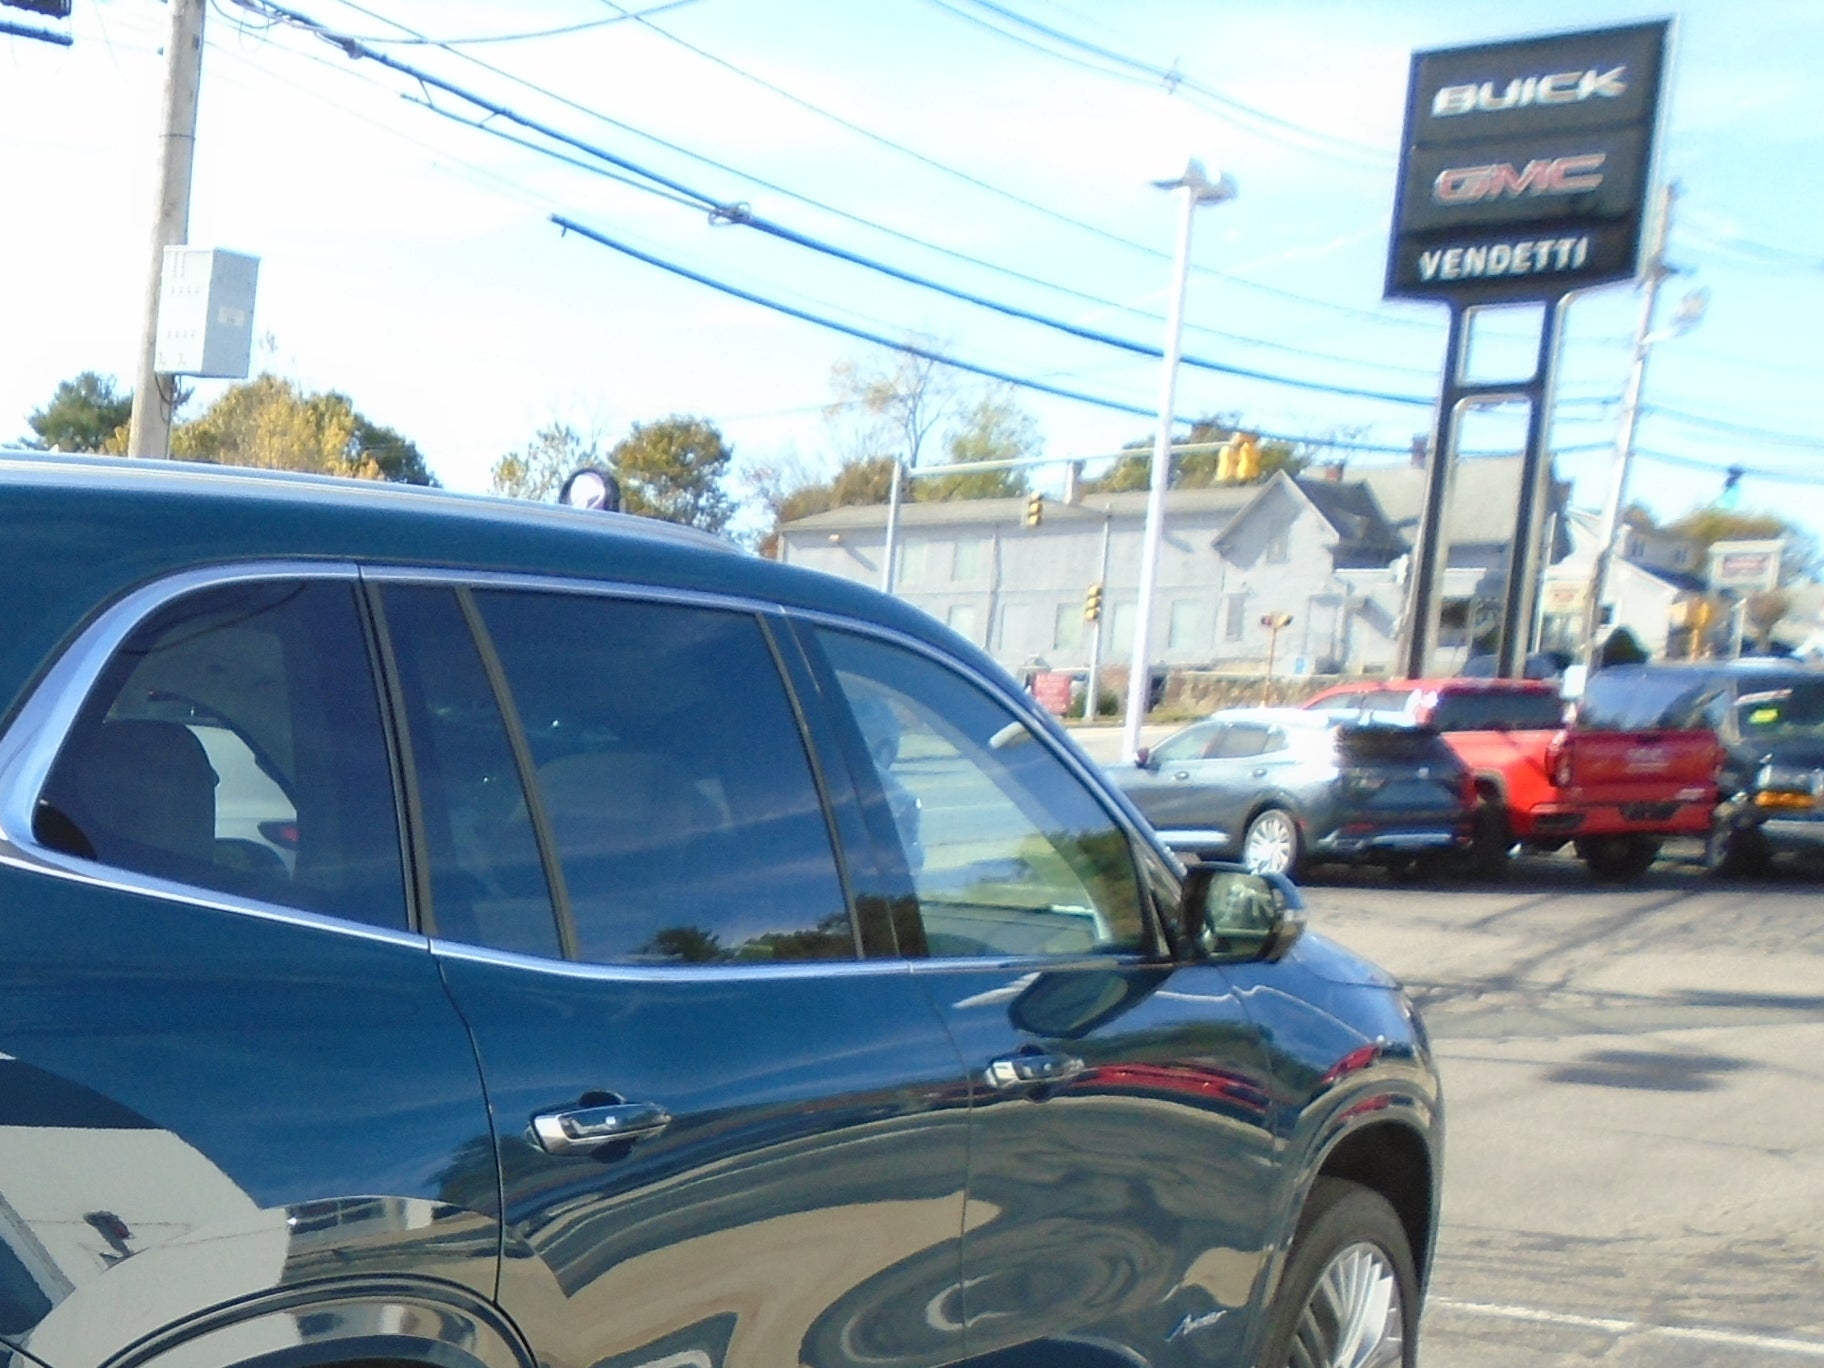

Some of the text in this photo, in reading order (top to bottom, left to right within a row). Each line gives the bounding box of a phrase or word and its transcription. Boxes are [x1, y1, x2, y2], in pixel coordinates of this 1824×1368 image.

[1430, 66, 1629, 117] BUICK
[1433, 153, 1607, 203] GMC
[1418, 236, 1590, 280] VENDETTI
